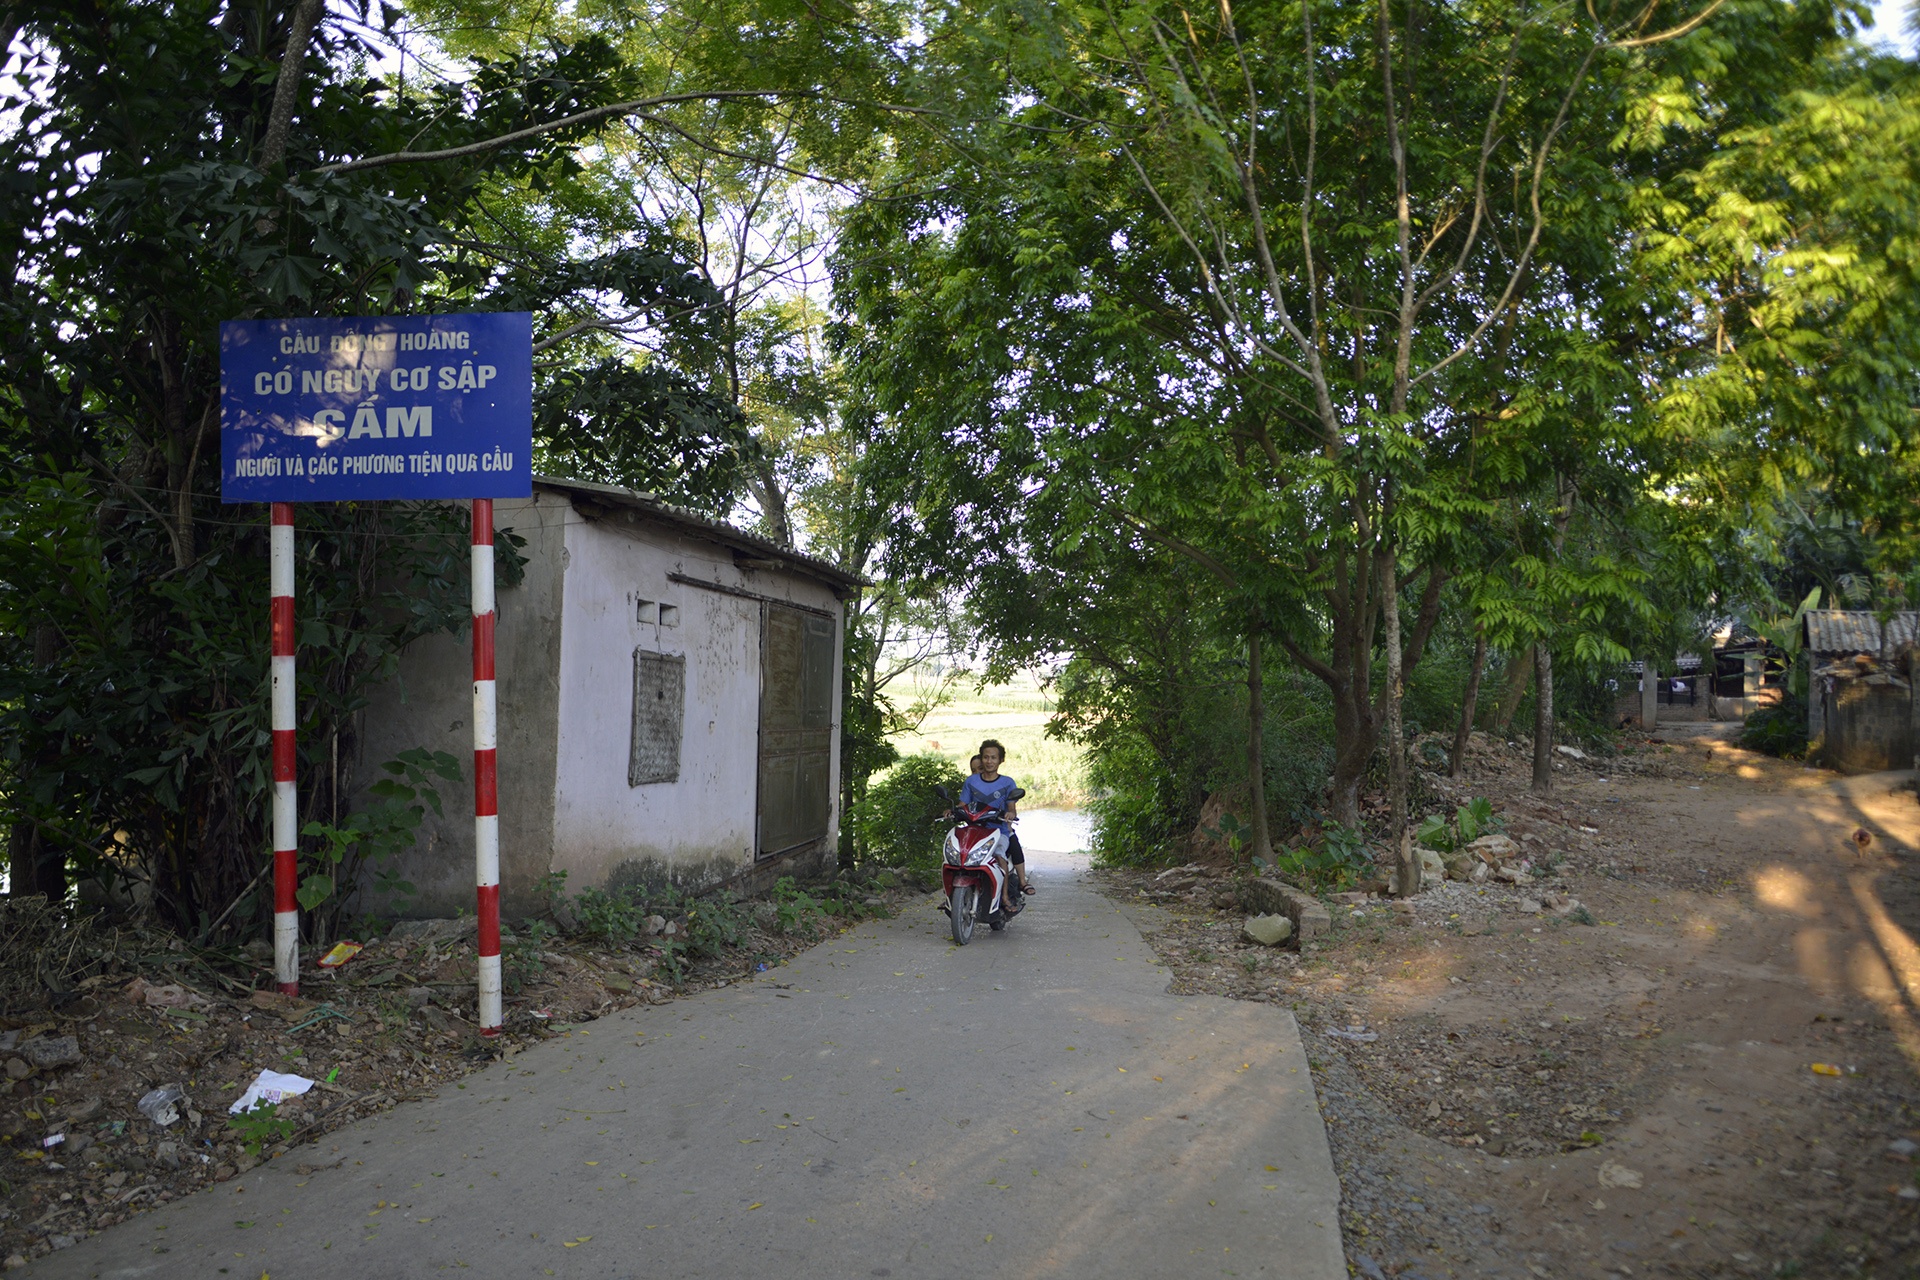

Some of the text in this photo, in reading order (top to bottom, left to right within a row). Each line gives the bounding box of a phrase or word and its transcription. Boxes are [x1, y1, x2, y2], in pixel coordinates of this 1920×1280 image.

[400, 328, 470, 351] HOÀNG
[255, 360, 497, 395] CÓ NGUY CƠ SẬP
[313, 394, 433, 440] CẤM
[235, 445, 513, 477] NGƯỜI VÀ CÁC PHƯƠNG TIỆN QUA CẦU
